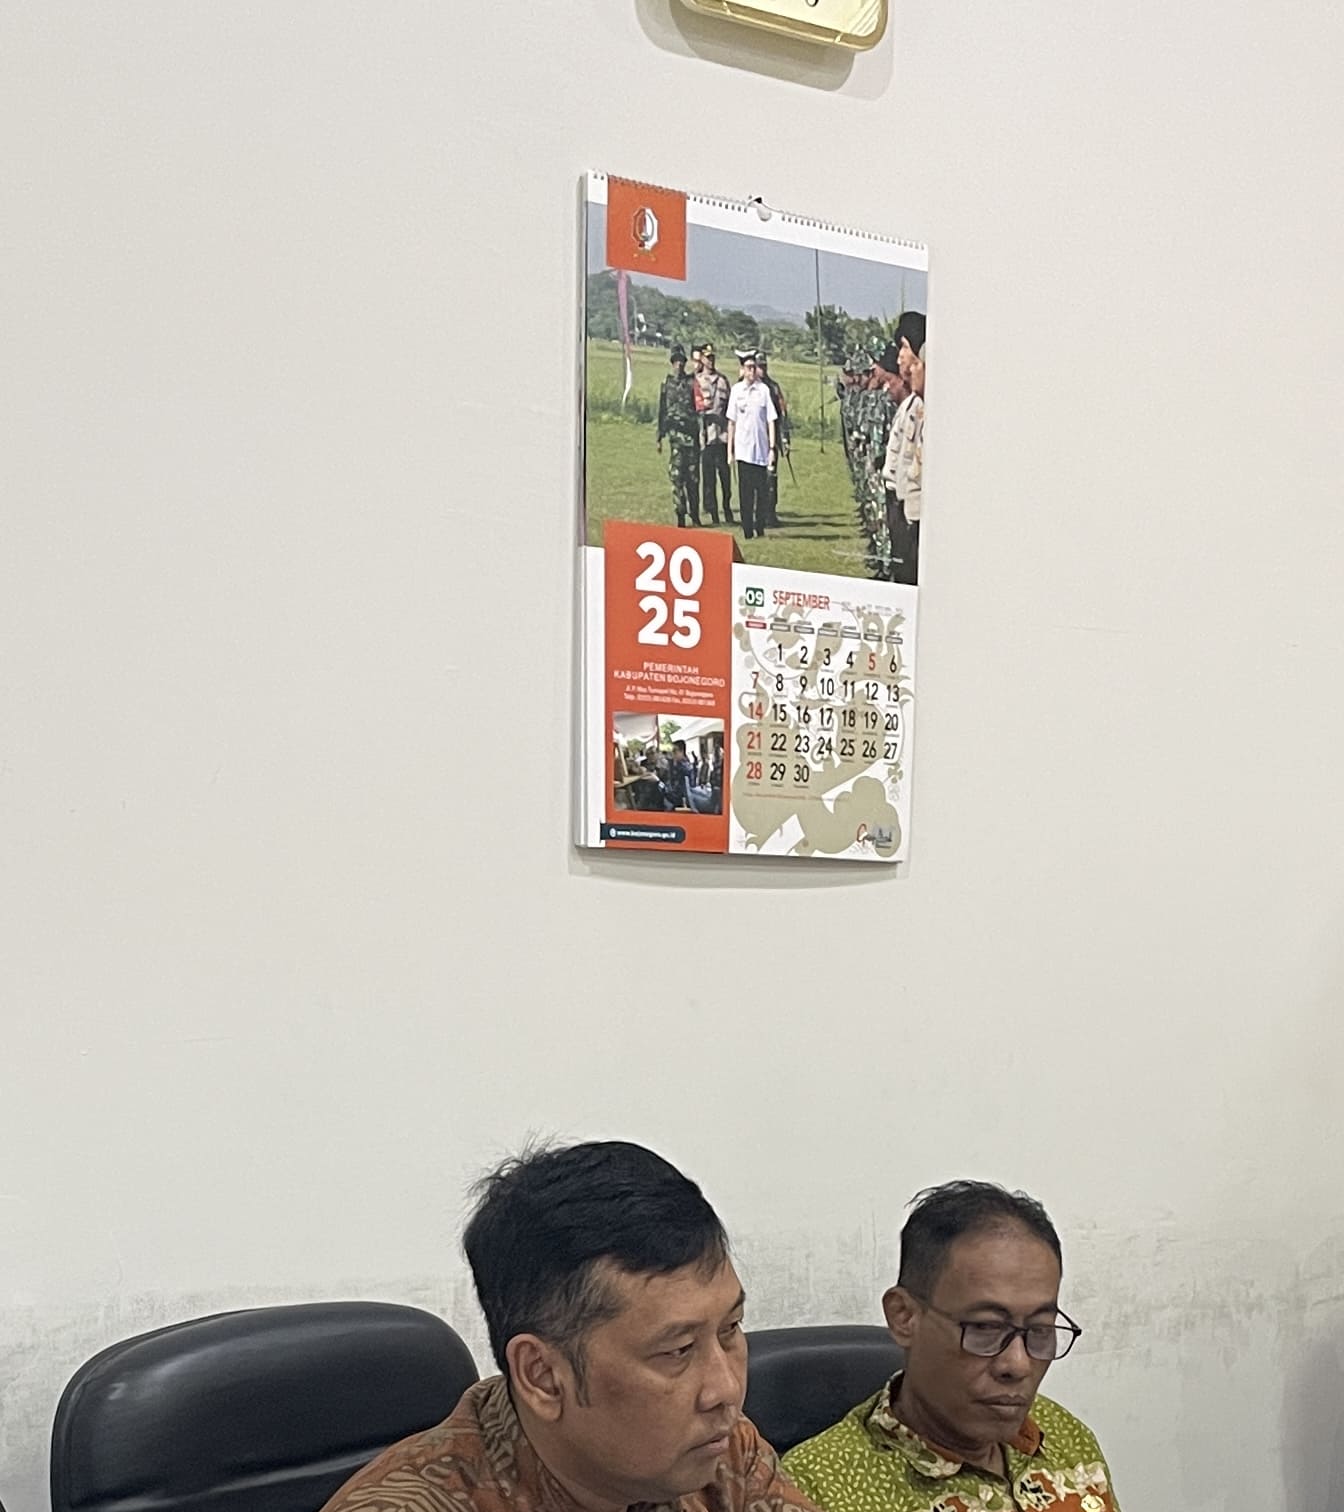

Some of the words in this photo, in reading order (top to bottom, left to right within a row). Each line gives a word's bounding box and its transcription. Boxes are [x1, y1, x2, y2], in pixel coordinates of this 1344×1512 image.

[635, 541, 704, 597] 20
[746, 589, 763, 606] 09
[772, 590, 830, 610] SEPTEMBER
[637, 594, 702, 649] 25
[777, 643, 783, 662] 1
[799, 645, 809, 665] 2
[822, 648, 831, 667] 3
[846, 651, 855, 669] 4
[868, 653, 876, 671] 5
[889, 655, 897, 673] 6
[613, 669, 666, 684] KABUPATEN
[666, 673, 726, 688] BOJONEGORO
[751, 671, 760, 690] 7
[775, 673, 784, 692] 8
[799, 676, 808, 694] 9
[819, 678, 835, 696] 10
[843, 679, 856, 699] 11
[865, 682, 879, 701] 12
[887, 684, 900, 703] 13
[748, 702, 764, 721] 14
[772, 703, 787, 723] 15
[796, 705, 811, 724] 16
[819, 707, 834, 727] 17
[841, 709, 856, 728] 18
[863, 711, 878, 730] 19
[884, 713, 899, 732] 20
[747, 731, 762, 750] 21
[770, 732, 787, 751] 22
[794, 734, 810, 754] 23
[817, 736, 832, 756] 24
[840, 738, 855, 757] 25
[862, 740, 877, 759] 26
[883, 742, 898, 760] 27
[746, 761, 762, 780] 28
[770, 762, 786, 781] 29
[793, 764, 810, 783] 30
